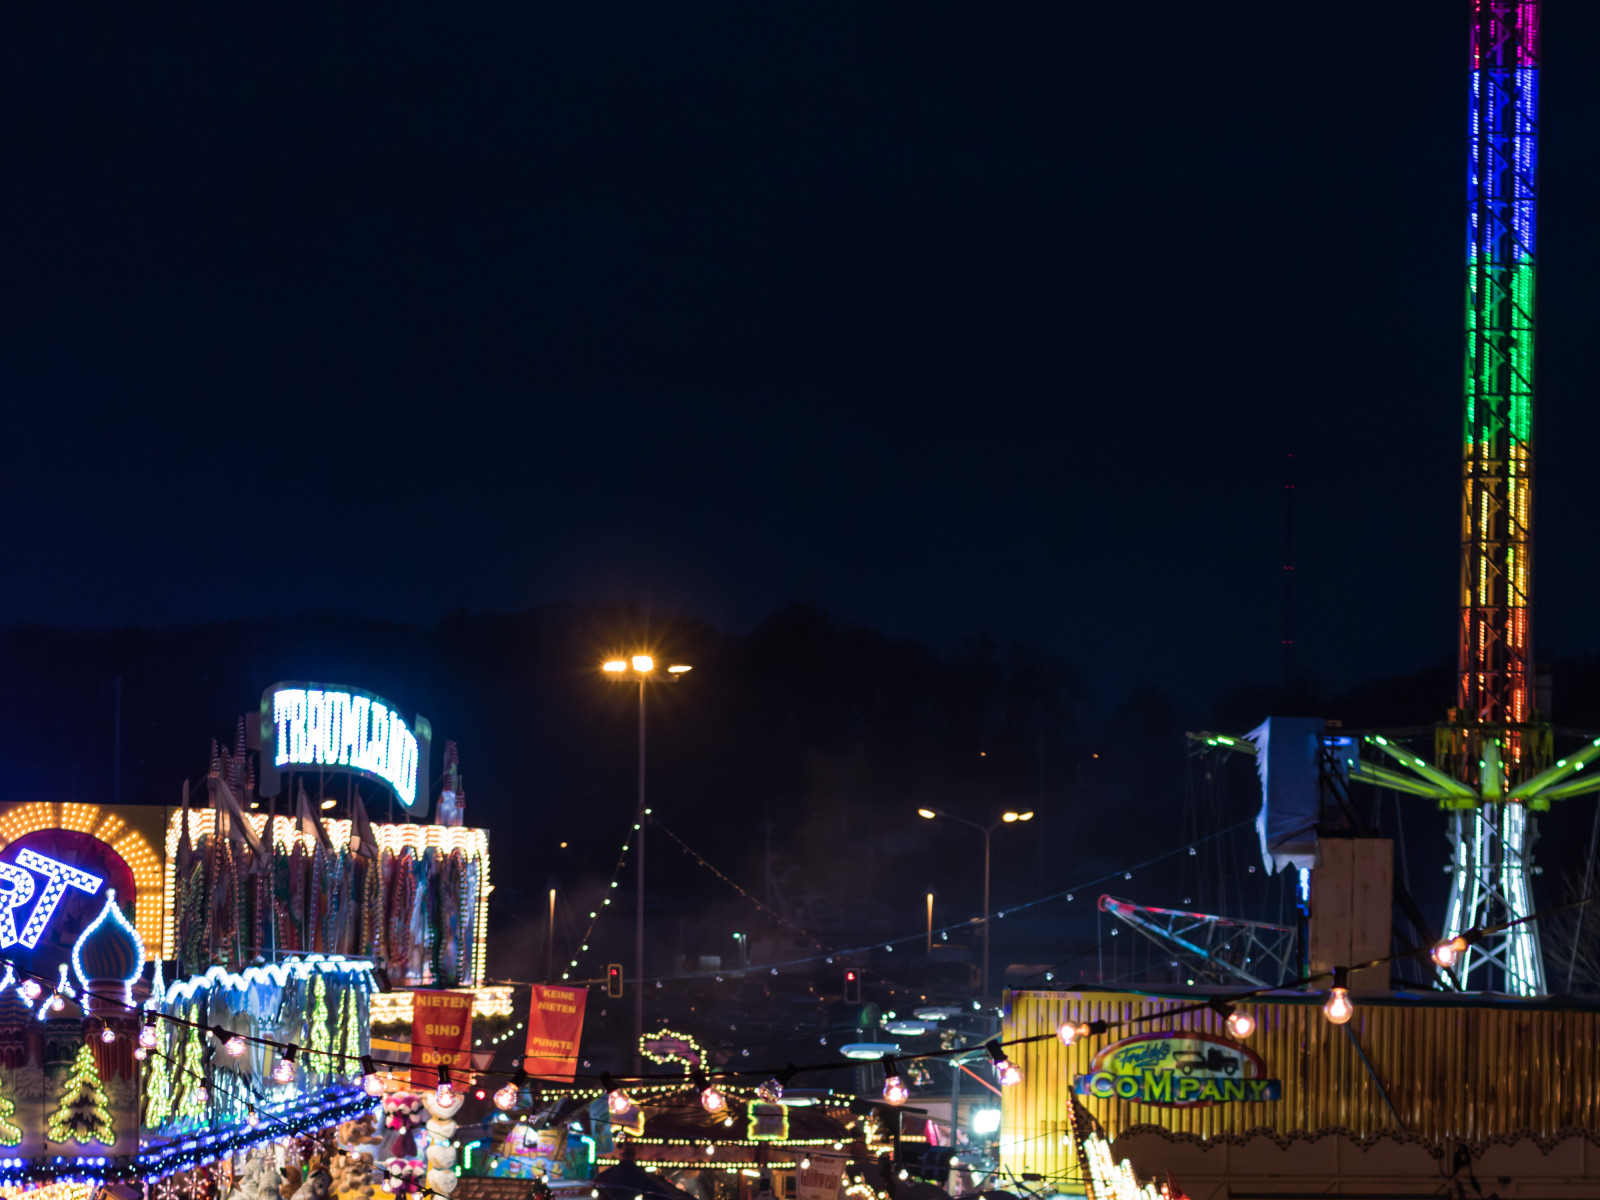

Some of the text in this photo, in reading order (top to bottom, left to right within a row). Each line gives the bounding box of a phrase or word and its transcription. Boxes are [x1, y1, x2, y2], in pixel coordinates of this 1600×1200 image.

[416, 994, 469, 1009] NIETEN
[542, 989, 575, 1001] KEINE
[538, 1001, 577, 1014] NIETEN
[424, 1024, 461, 1037] SIND
[532, 1036, 574, 1050] PUNKTE
[421, 1052, 462, 1066] DOOF
